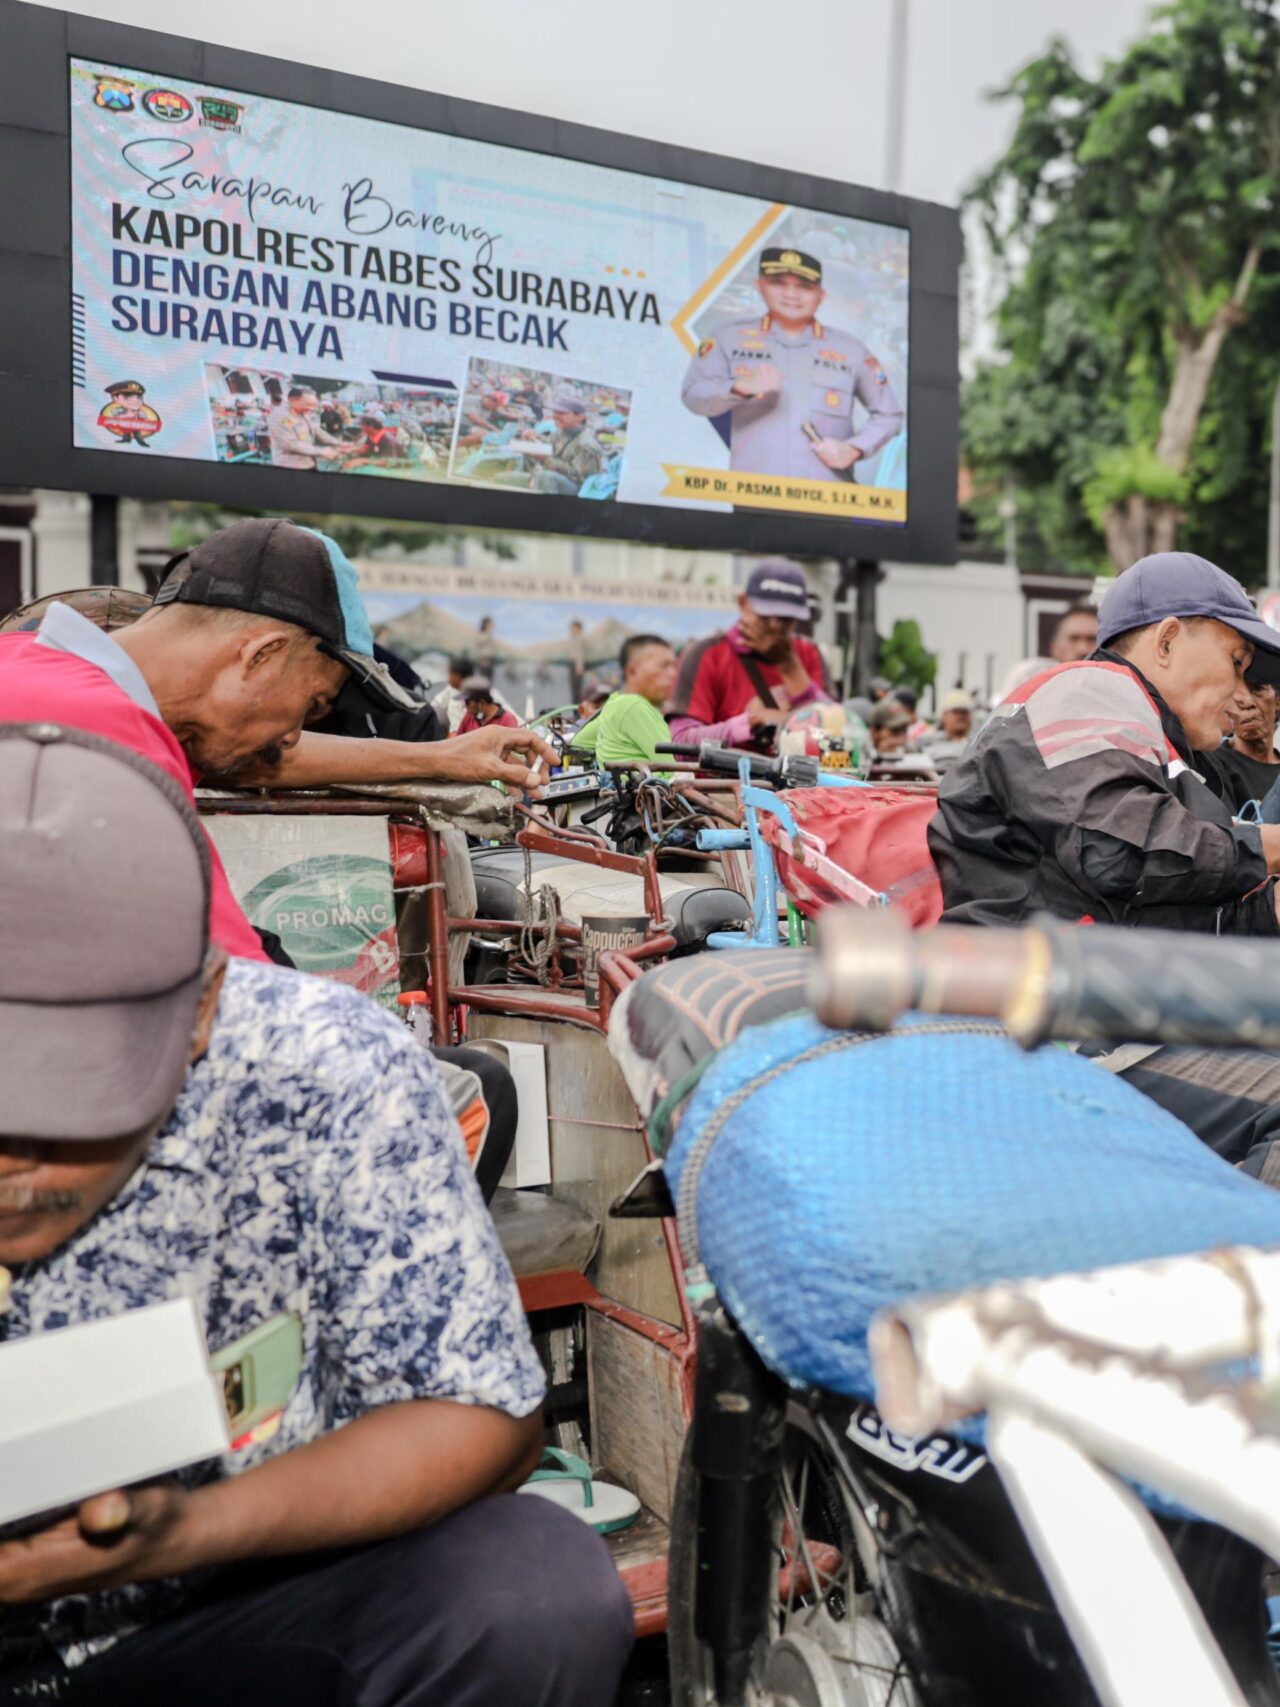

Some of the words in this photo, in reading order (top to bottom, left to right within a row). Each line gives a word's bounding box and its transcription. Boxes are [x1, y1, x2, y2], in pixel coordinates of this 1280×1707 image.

[122, 138, 325, 222] Sarapan
[342, 178, 502, 267] Bareng
[111, 202, 462, 293] KAPOLRESTABES
[472, 264, 662, 325] SURABAYA
[111, 248, 290, 311] DENGAN
[300, 279, 438, 332] ABANG
[449, 301, 570, 352] BECAK
[111, 294, 345, 361] SURABAYA
[685, 476, 709, 490] KBP
[736, 481, 782, 498] PASMA
[275, 903, 388, 931] PROMAG
